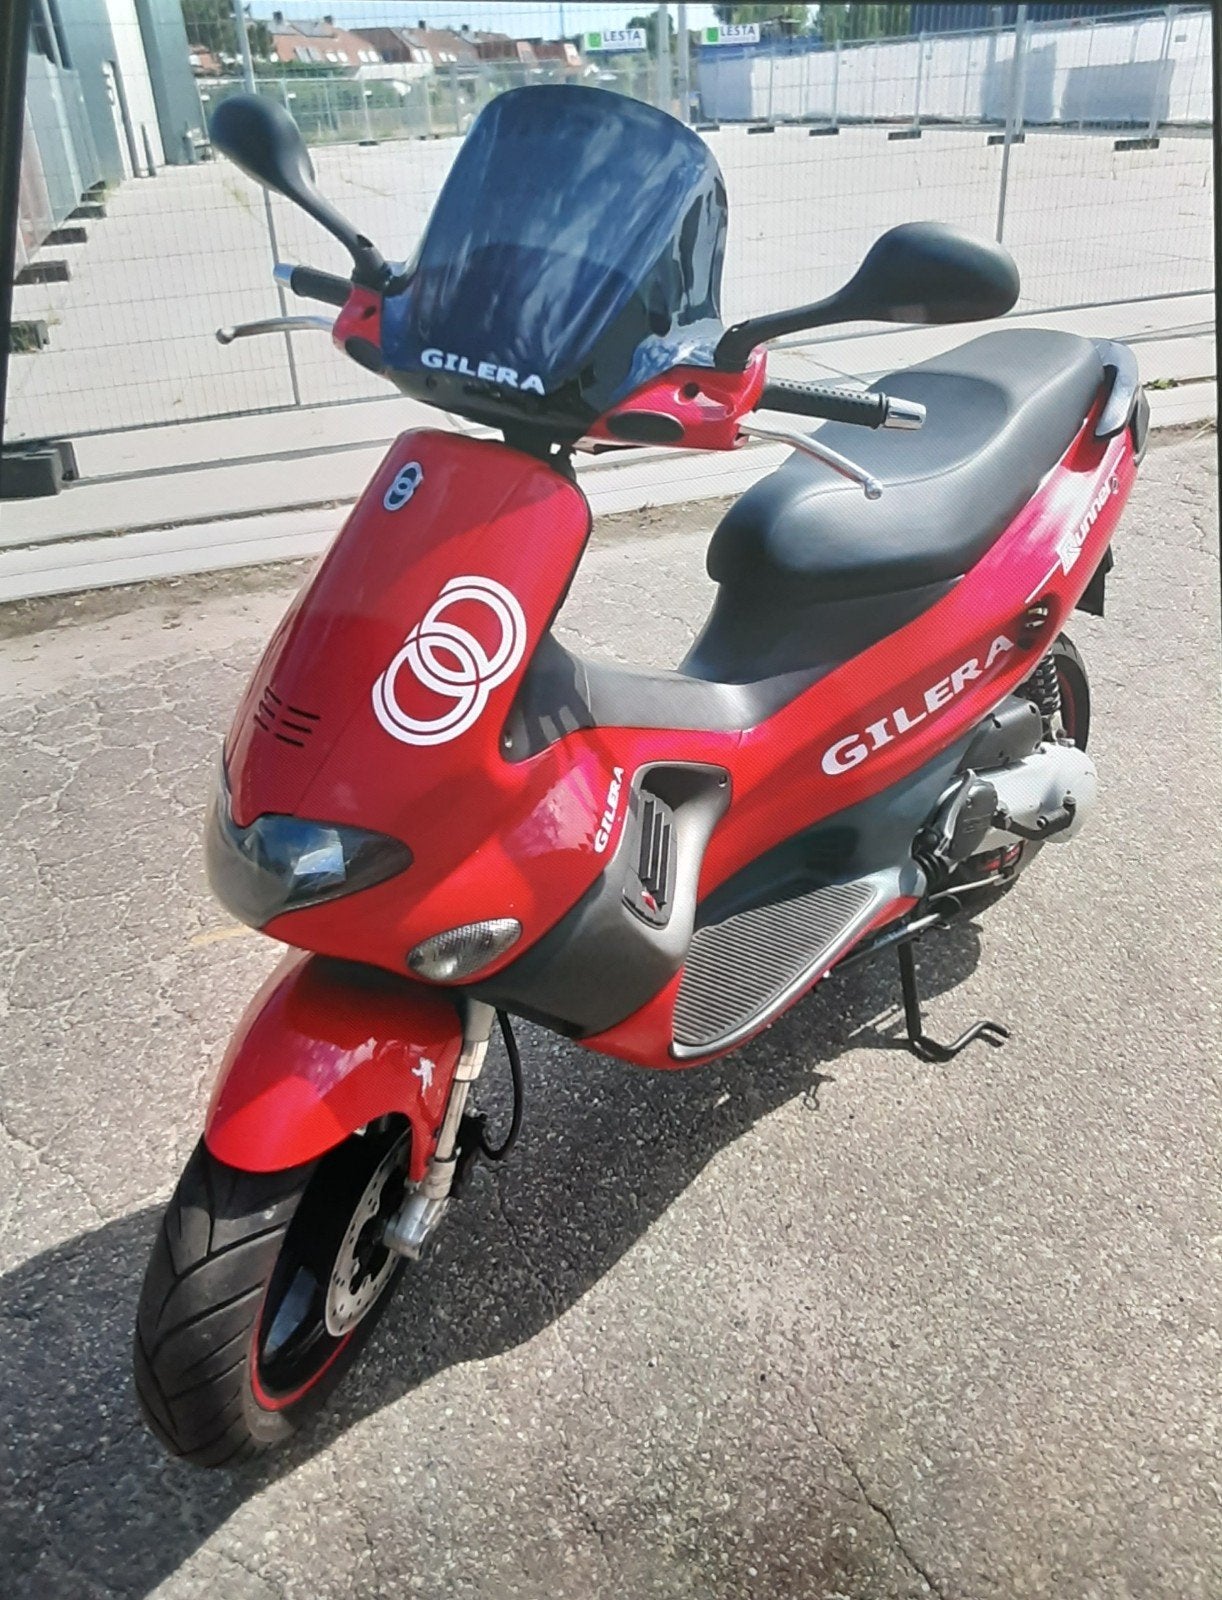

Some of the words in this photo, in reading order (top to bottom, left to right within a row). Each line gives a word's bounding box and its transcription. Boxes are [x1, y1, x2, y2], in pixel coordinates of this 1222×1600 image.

[603, 30, 641, 42] LESTA
[720, 25, 755, 37] LESTA
[420, 348, 546, 396] GILERA
[820, 634, 1015, 776] GILERA
[593, 766, 625, 853] GILERA
